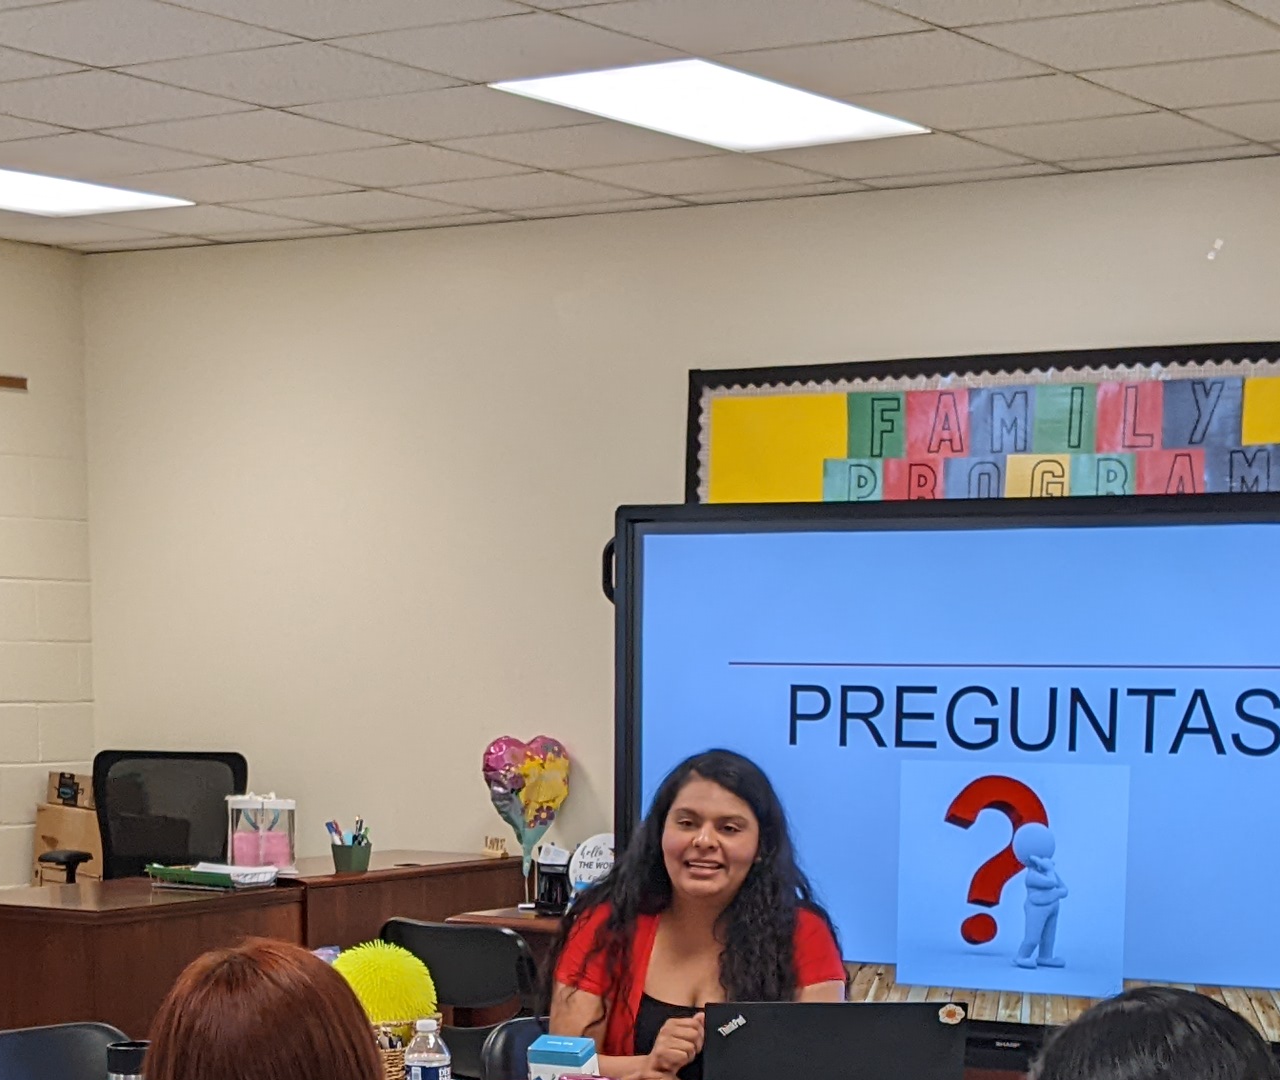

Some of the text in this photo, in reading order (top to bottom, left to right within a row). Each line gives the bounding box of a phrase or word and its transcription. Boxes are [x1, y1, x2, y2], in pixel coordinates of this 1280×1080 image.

[870, 386, 1224, 458] FAMILY
[847, 448, 1271, 500] PROGRAM
[578, 860, 594, 869] THE
[580, 844, 604, 859] hello
